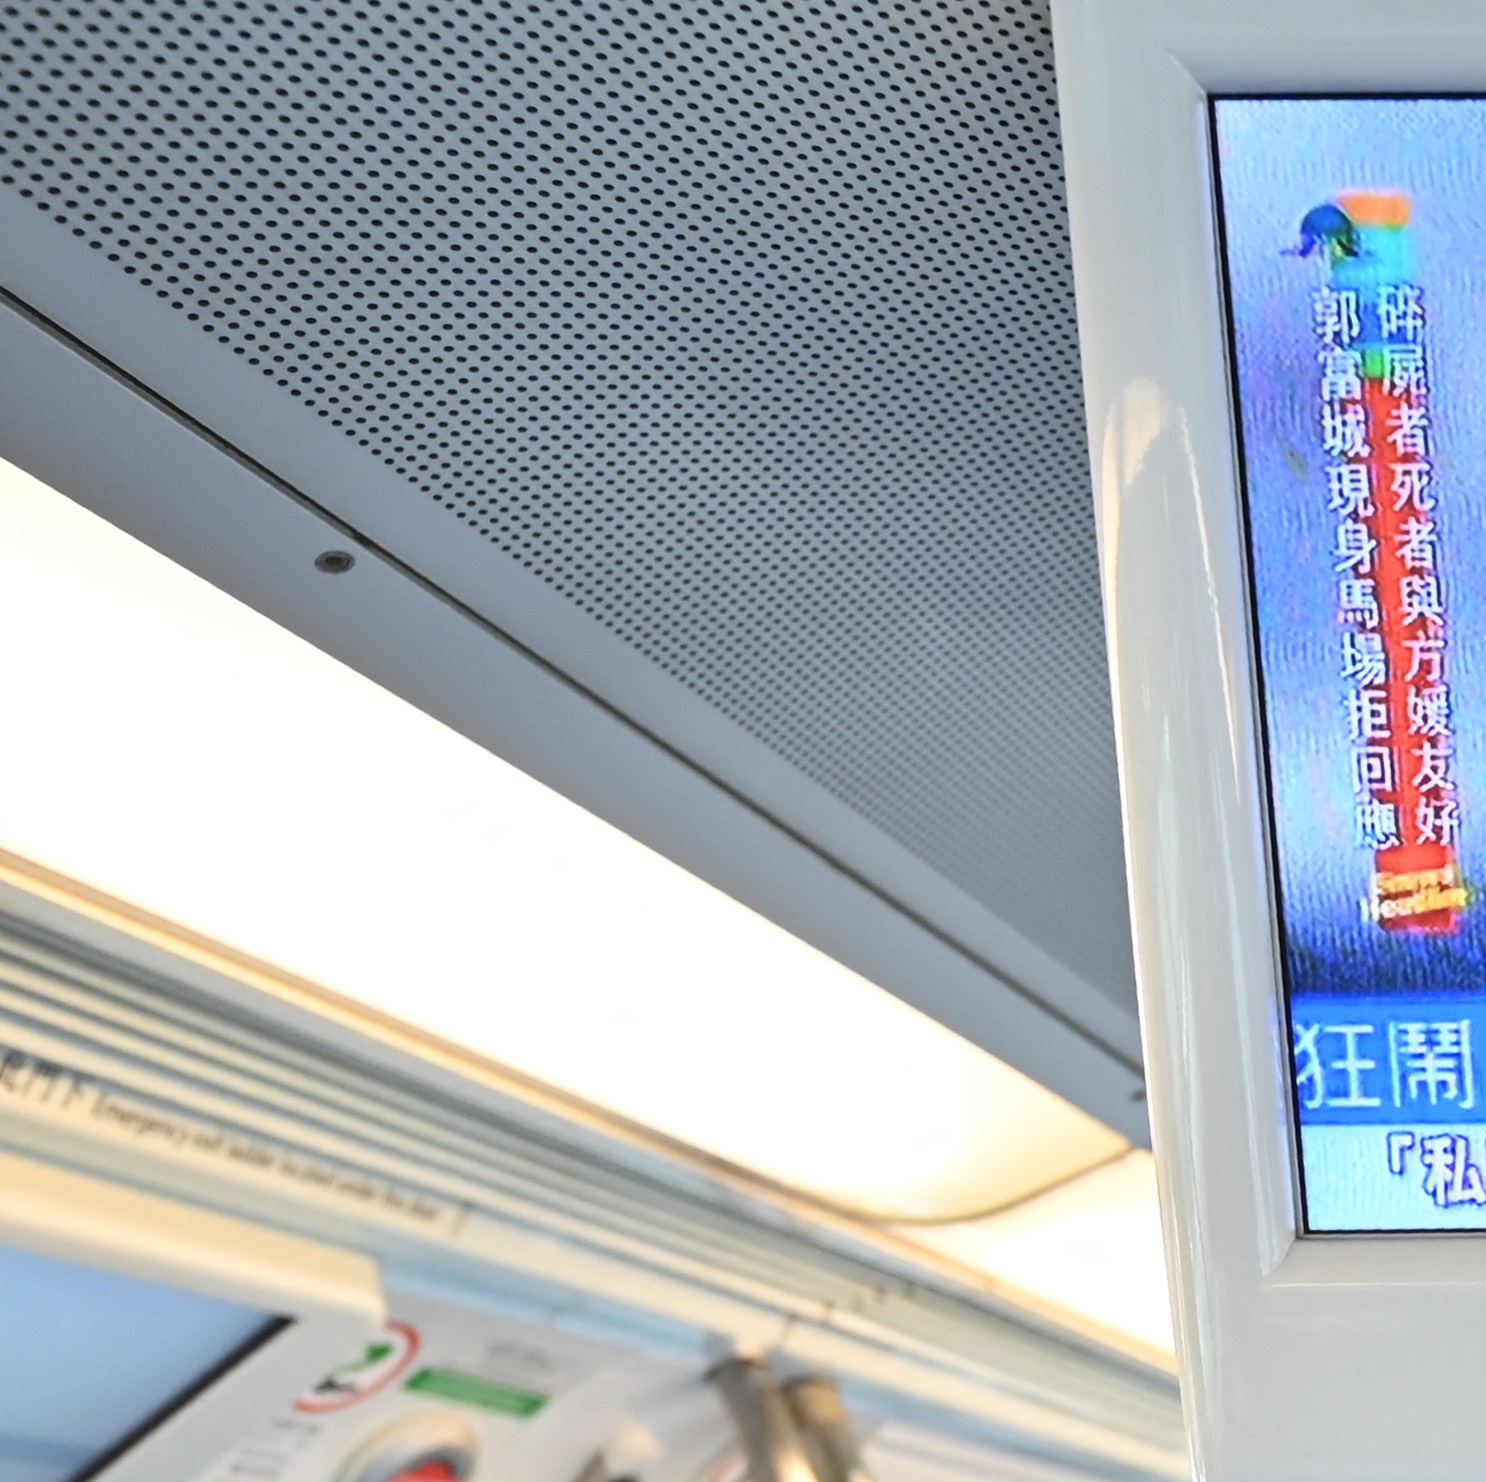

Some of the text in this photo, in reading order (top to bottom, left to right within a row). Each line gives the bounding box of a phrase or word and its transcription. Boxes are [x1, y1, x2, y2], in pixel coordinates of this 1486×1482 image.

[1309, 285, 1401, 849] 郭富城現身馬場拒回應
[1296, 1017, 1476, 1110] 狂鬧
